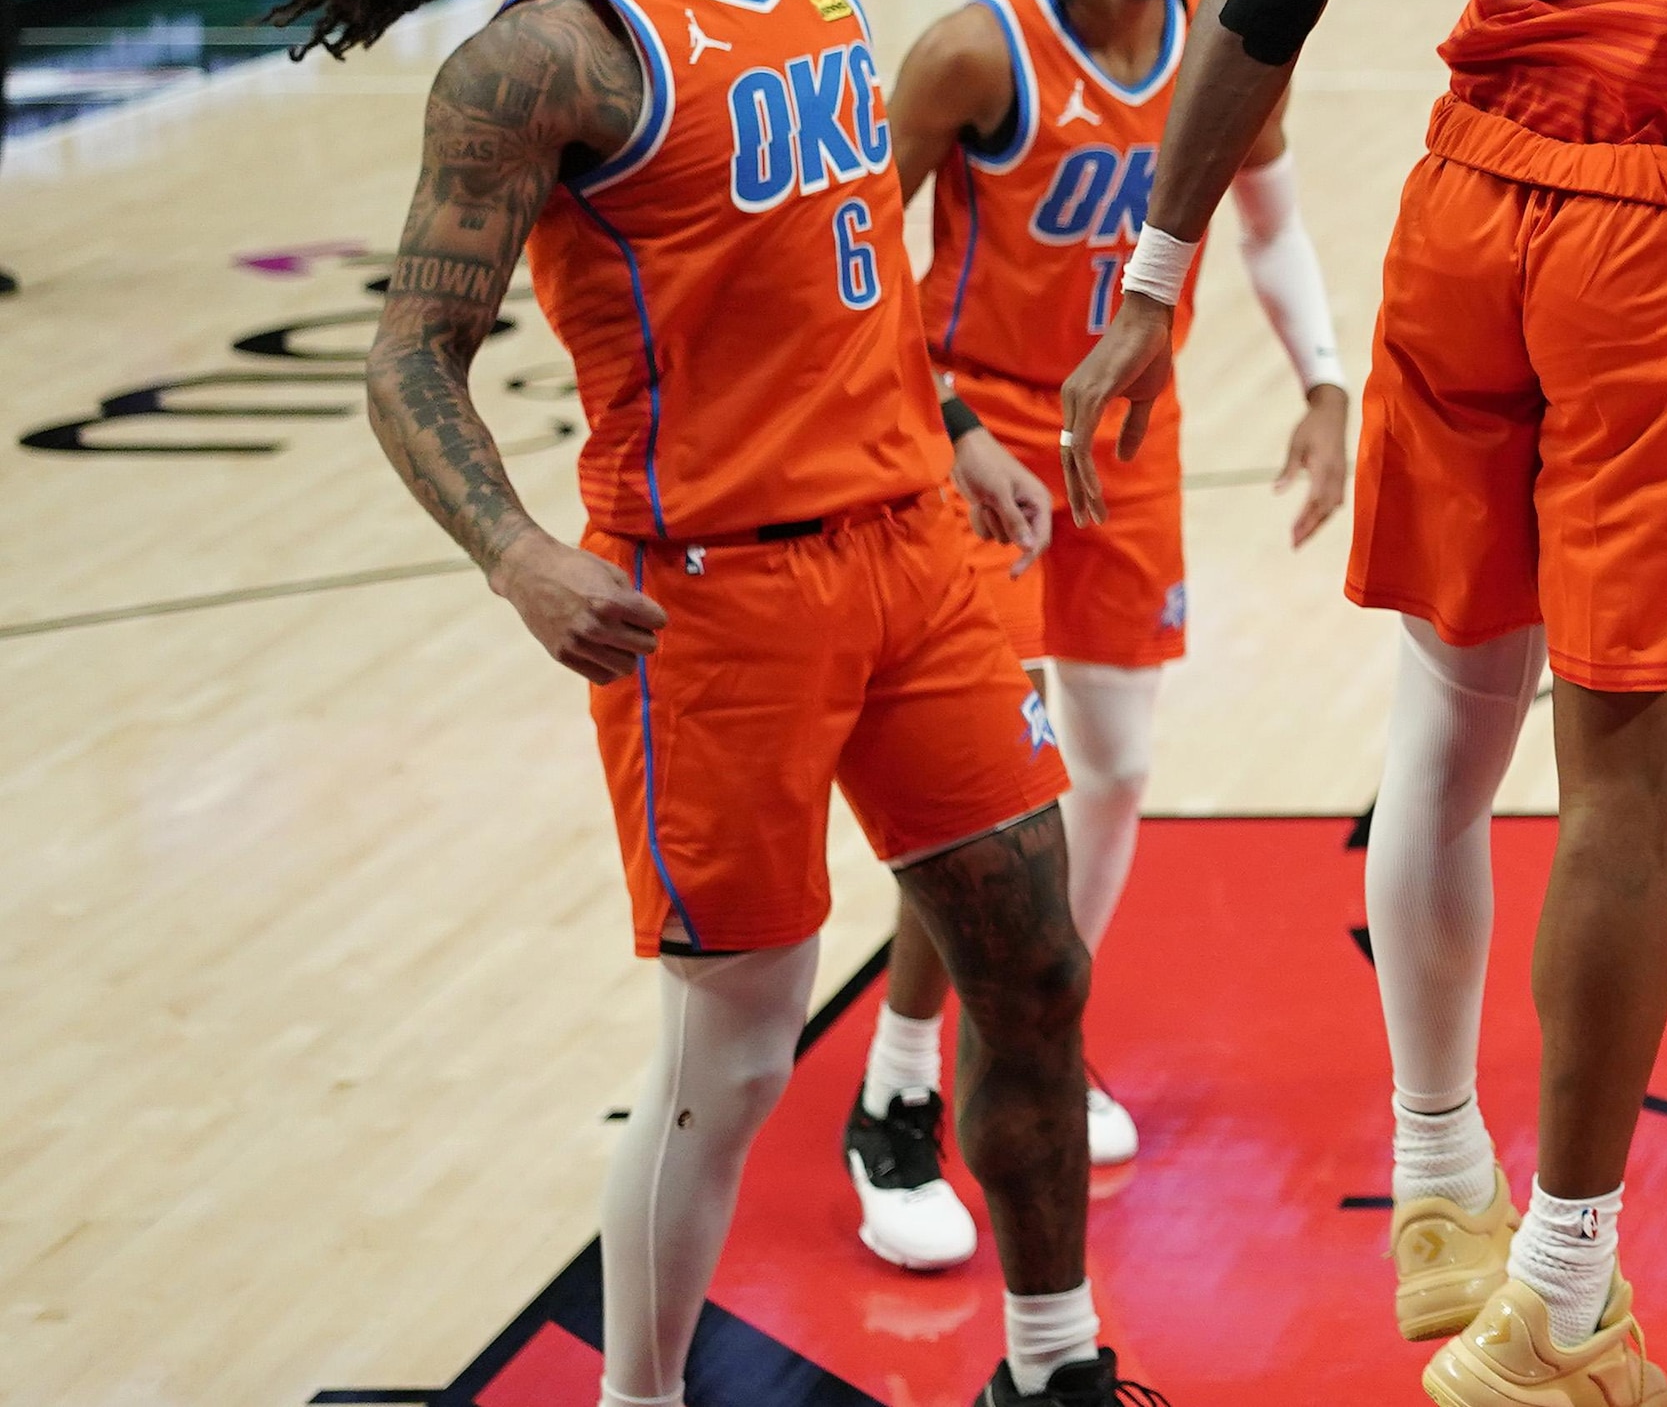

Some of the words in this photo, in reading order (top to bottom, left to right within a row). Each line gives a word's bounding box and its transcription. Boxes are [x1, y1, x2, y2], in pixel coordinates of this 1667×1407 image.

[727, 39, 893, 214] OKC
[1028, 142, 1160, 247] OK
[832, 196, 882, 311] 6
